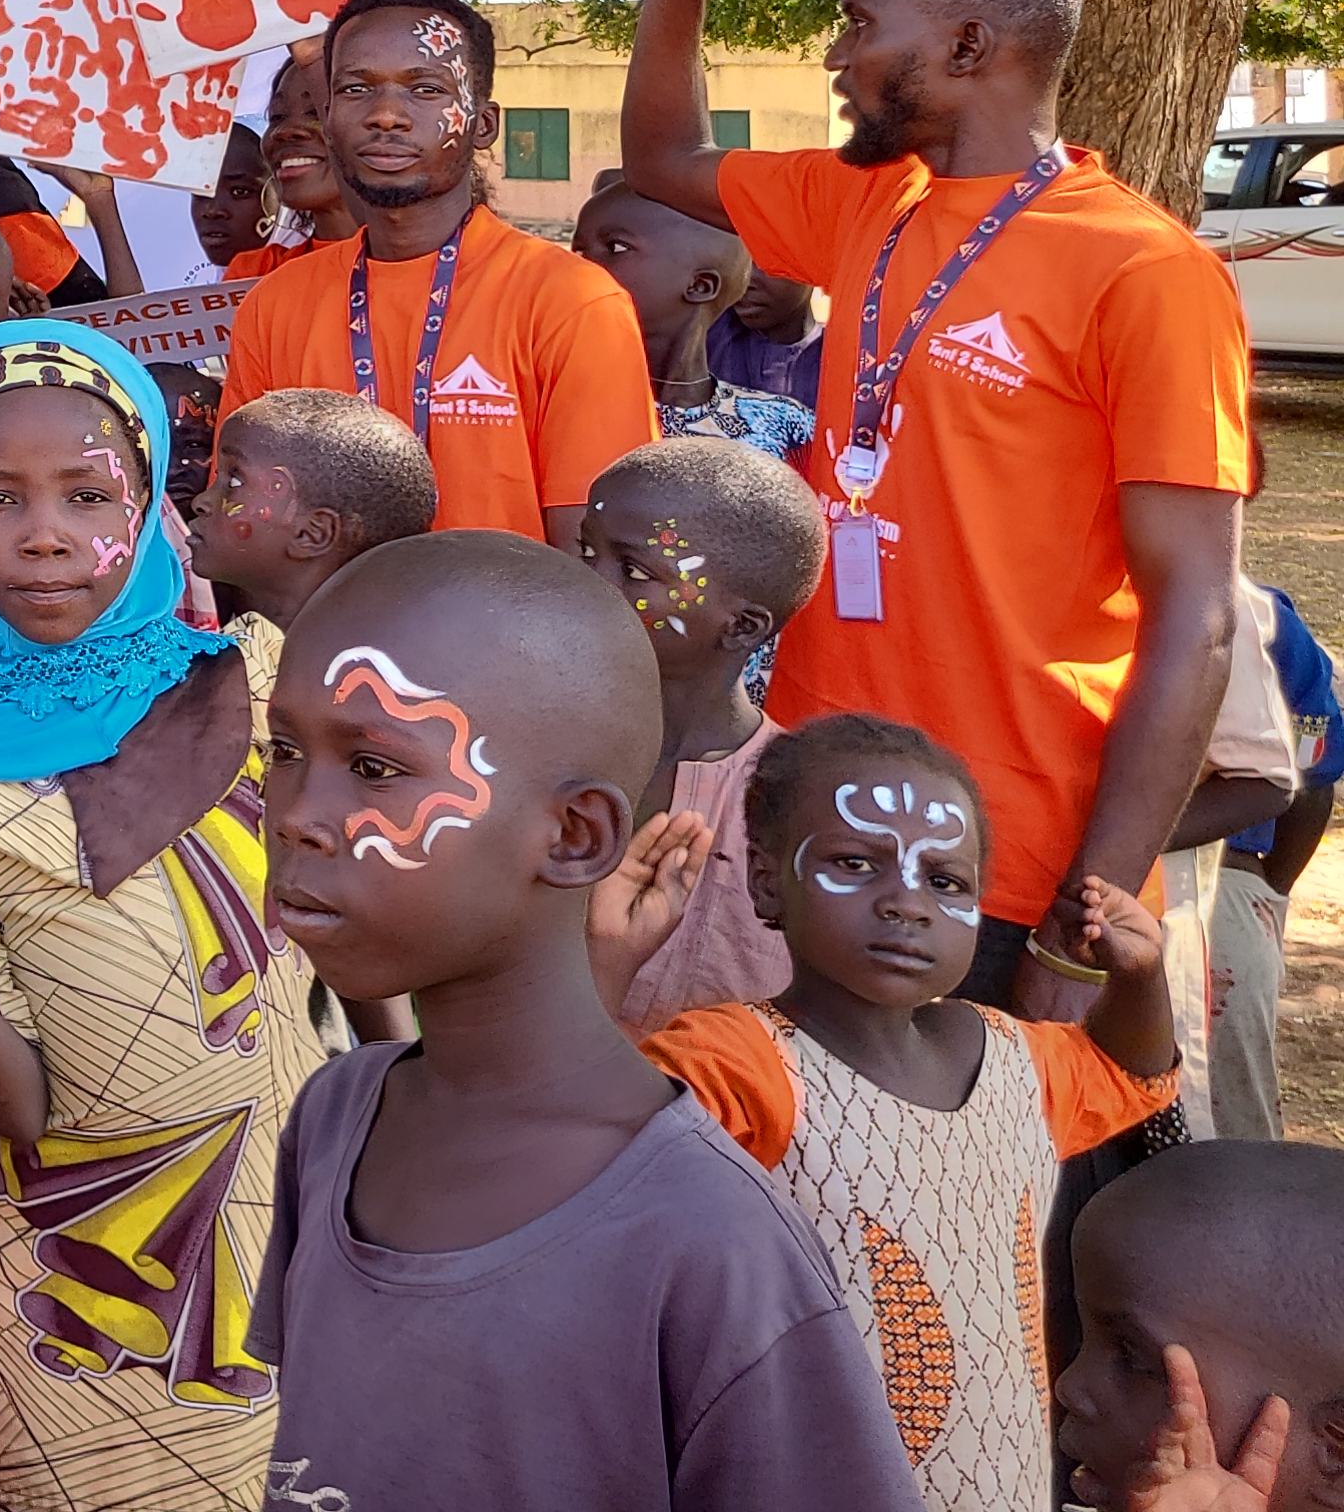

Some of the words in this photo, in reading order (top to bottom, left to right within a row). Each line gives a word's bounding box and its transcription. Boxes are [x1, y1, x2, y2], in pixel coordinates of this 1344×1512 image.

[201, 290, 246, 311] BE
[927, 358, 1016, 397] INITIATIVE
[928, 338, 958, 362] Tent
[957, 350, 971, 367] 2
[970, 356, 1025, 388] School
[468, 399, 518, 416] School
